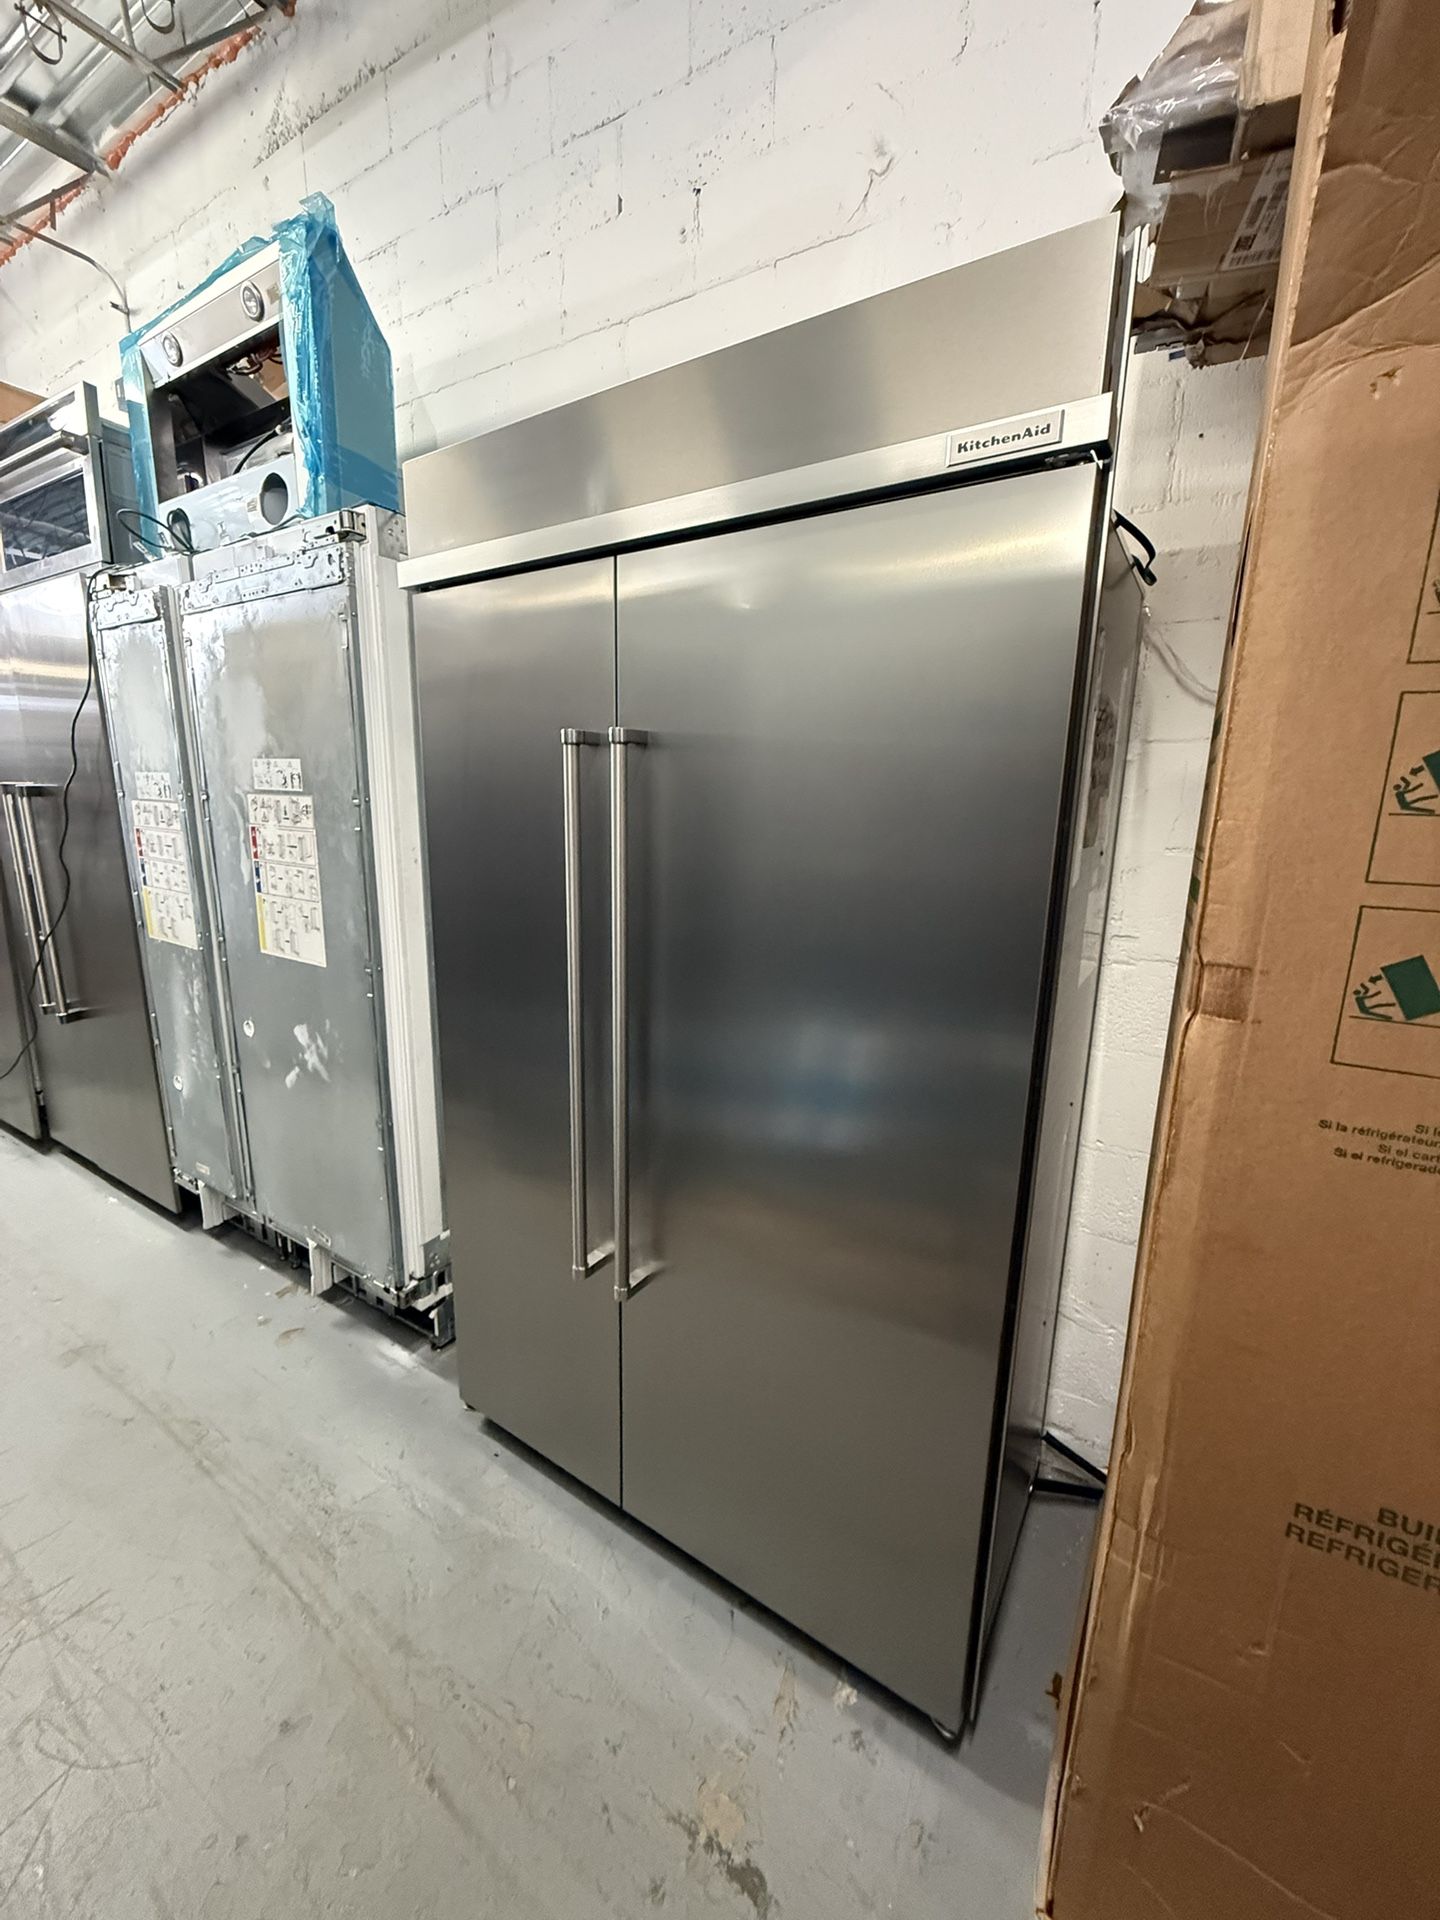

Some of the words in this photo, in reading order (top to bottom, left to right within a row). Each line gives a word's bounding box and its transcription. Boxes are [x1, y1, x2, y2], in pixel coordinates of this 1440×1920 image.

[957, 423, 1051, 454] KitchenAid
[1318, 1119, 1333, 1130] Si
[1414, 1124, 1429, 1135] Si
[1333, 1146, 1348, 1159] Si
[1351, 1152, 1364, 1161] el
[1377, 1143, 1392, 1155] Si
[1396, 1148, 1408, 1158] el
